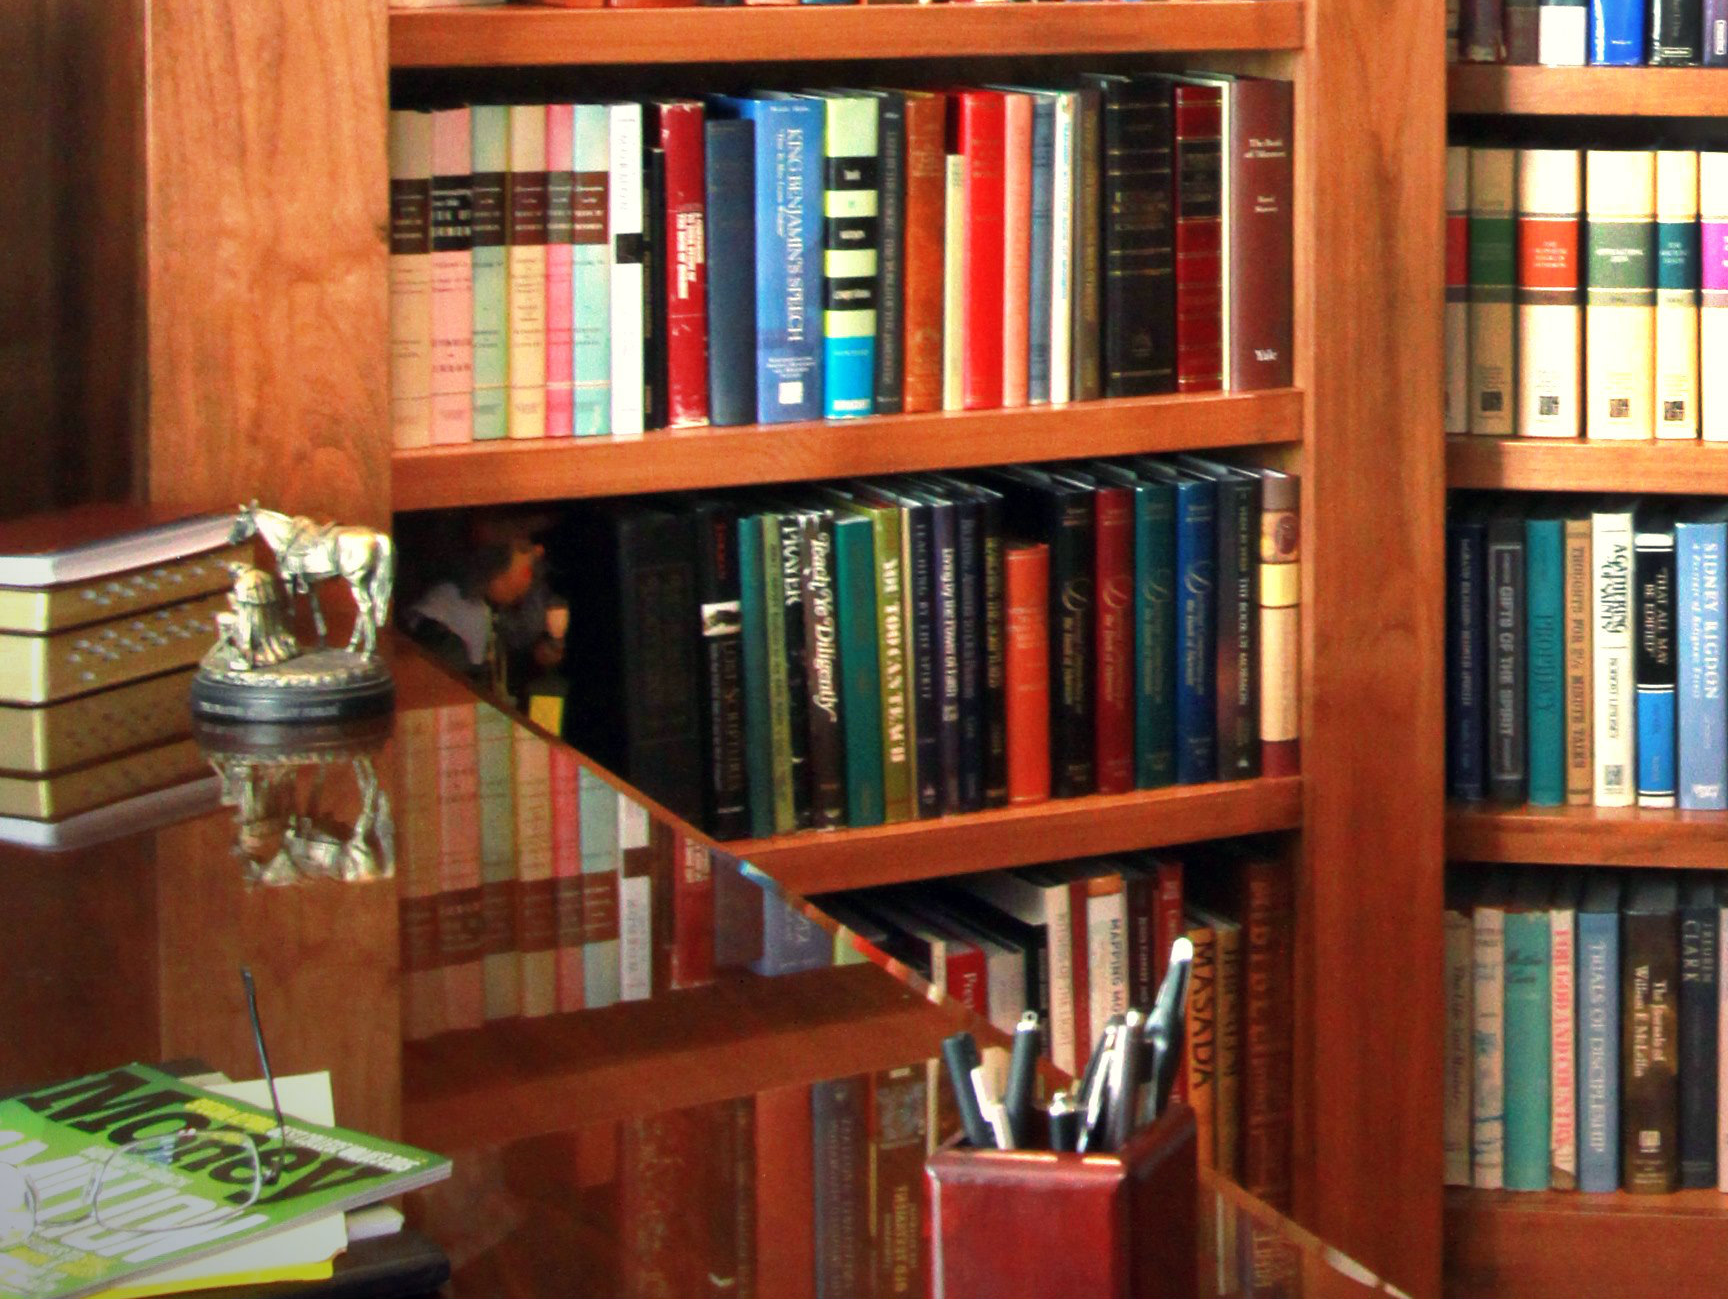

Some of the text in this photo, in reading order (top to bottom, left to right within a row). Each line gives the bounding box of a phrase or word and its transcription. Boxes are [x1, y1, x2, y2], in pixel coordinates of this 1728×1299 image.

[787, 129, 803, 172] KING
[783, 175, 803, 274] BENJAMIN'S
[781, 526, 803, 607] PRAYER
[1572, 546, 1585, 613] THOUGHTS
[1611, 555, 1629, 634] GATHERING
[807, 532, 838, 723] Teach Ye Diligently
[1498, 586, 1513, 737] GIFTS OF THE SPIRIT
[1572, 619, 1585, 643] FOR
[1656, 612, 1668, 634] ALL
[1656, 638, 1668, 666] MAY
[1703, 543, 1719, 700] SIDNEY RIGDON
[1533, 612, 1556, 713] PROPHECY
[1650, 981, 1666, 1002] The
[1682, 920, 1697, 982] CLARK
[1193, 941, 1216, 1089] MASADA
[1589, 941, 1607, 1153] TRIALS OF DISCIPLESHIP
[15, 1070, 396, 1205] Money
